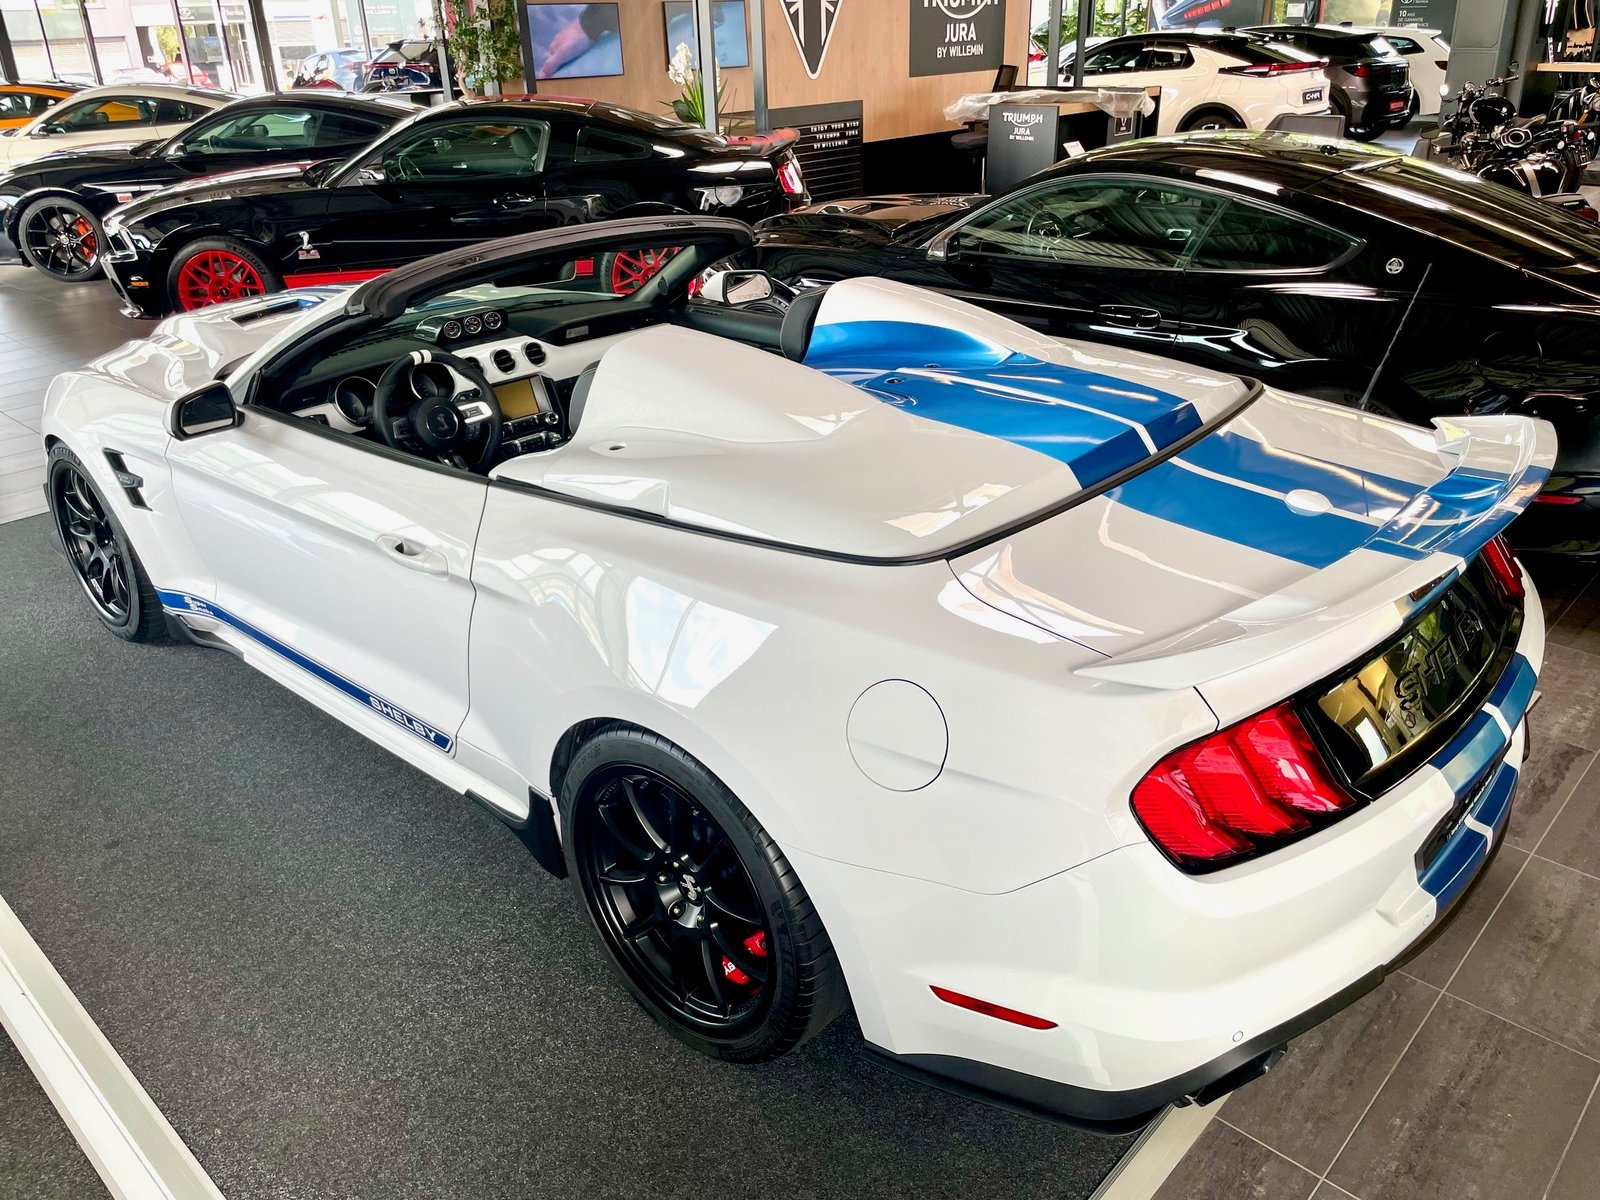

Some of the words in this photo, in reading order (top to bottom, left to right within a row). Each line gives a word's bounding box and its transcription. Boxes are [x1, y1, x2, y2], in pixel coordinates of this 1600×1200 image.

[944, 22, 977, 43] JURA
[936, 46, 947, 59] BY
[949, 43, 984, 57] WILLEMIN
[1305, 92, 1321, 101] C-HR
[1002, 112, 1044, 124] TRIUMPH
[1013, 127, 1031, 136] JURA
[1394, 607, 1483, 711] SHELBY
[369, 696, 436, 742] SHELBY
